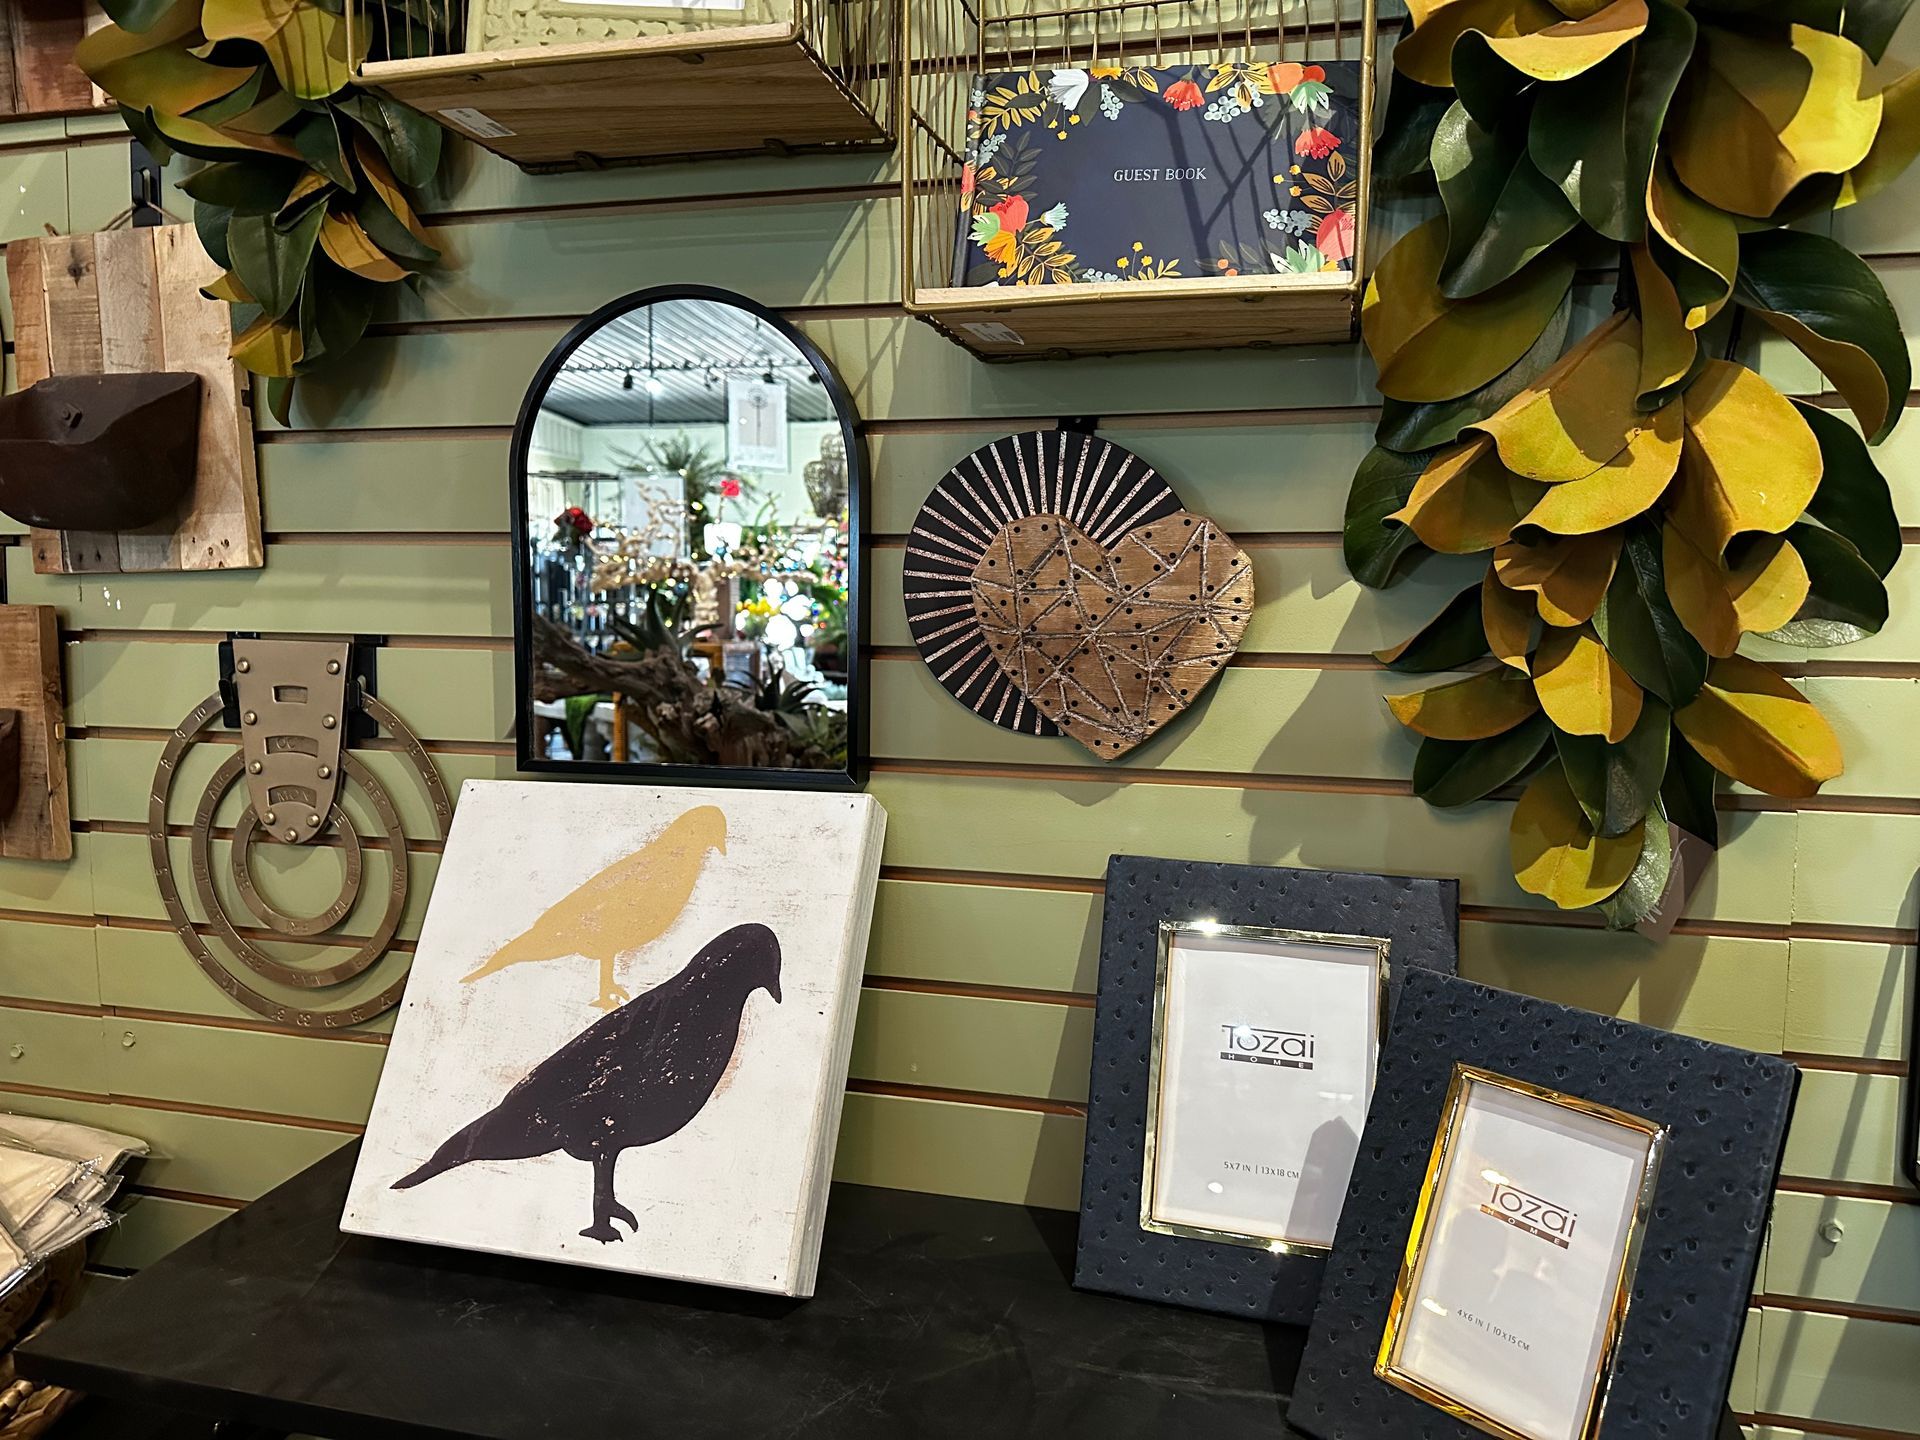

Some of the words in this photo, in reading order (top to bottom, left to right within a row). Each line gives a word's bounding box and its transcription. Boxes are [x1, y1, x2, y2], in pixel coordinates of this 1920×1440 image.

[1113, 168, 1160, 182] GUEST
[1165, 167, 1207, 180] BOOK
[160, 758, 174, 770] 8
[362, 777, 389, 810] DEC
[392, 862, 407, 896] JAN
[1221, 1024, 1315, 1059] Tozai
[1227, 1053, 1305, 1069] HOME
[1242, 1163, 1251, 1173] IN
[1286, 1169, 1300, 1179] CM
[1486, 1207, 1562, 1246] HOME
[1475, 1317, 1484, 1328] IN
[1517, 1339, 1531, 1352] CM
